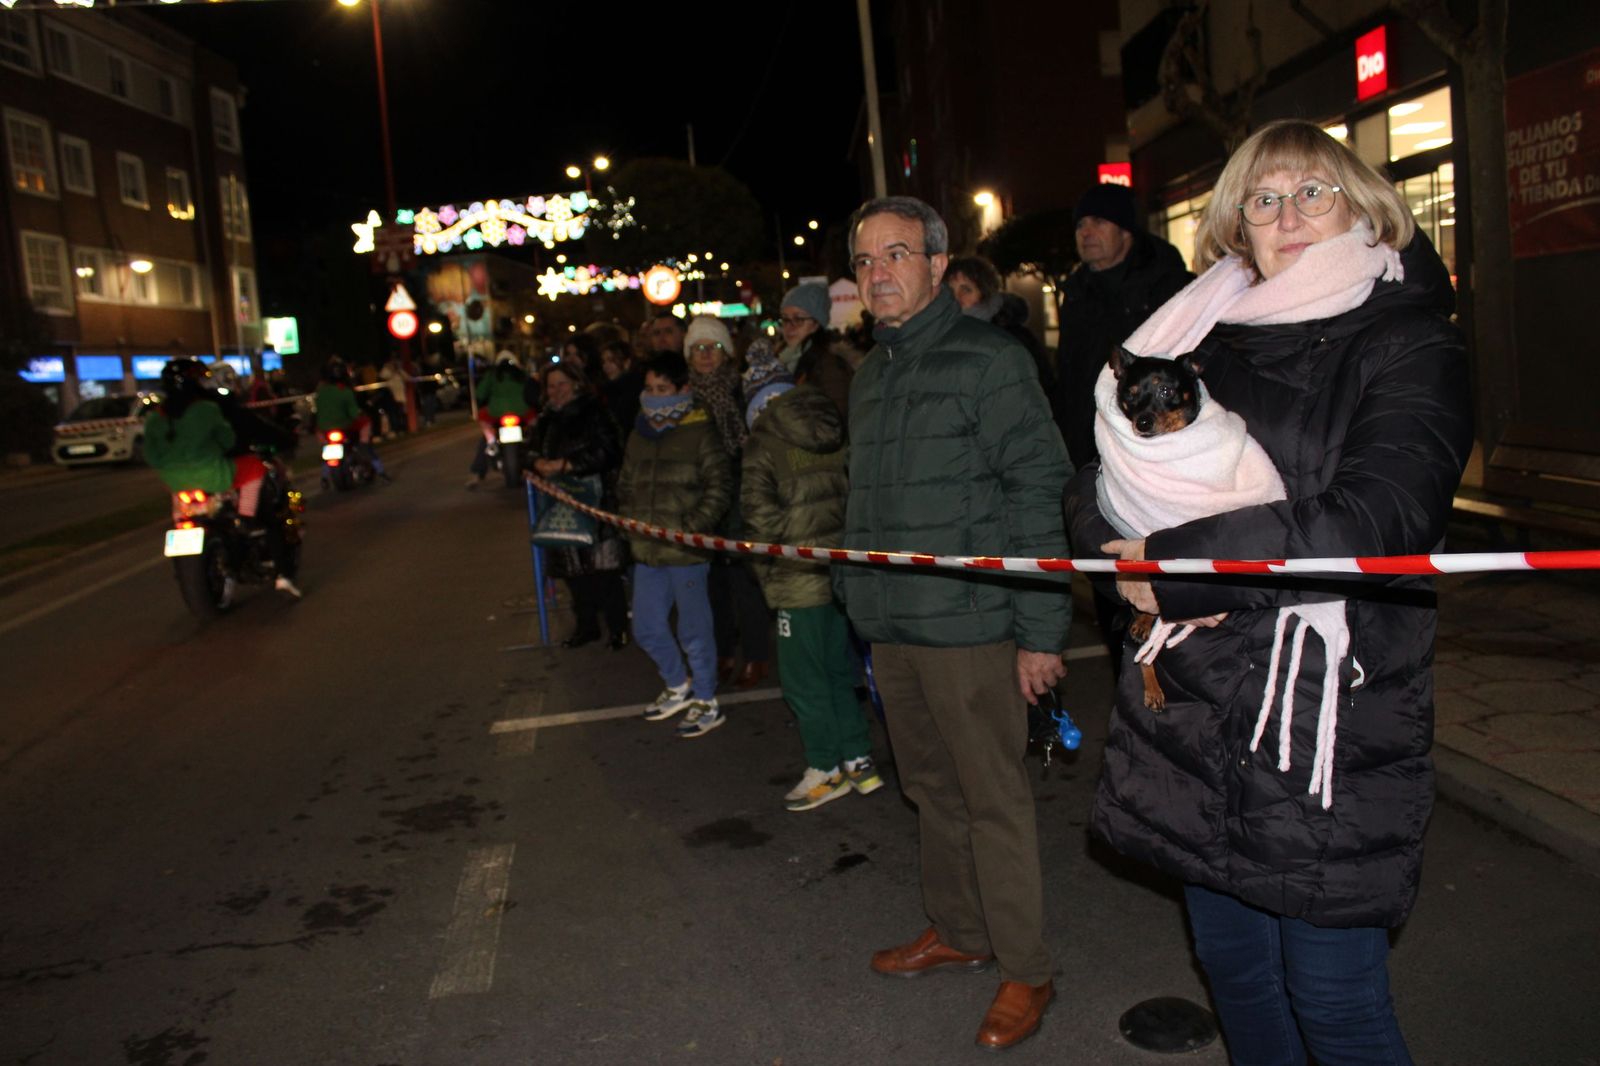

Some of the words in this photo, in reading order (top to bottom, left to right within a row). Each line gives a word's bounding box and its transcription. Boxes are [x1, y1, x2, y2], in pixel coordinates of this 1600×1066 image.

[1506, 112, 1583, 144] PLIAMOS
[1507, 135, 1577, 167] SURTIDO
[1520, 165, 1541, 184] DE
[1545, 160, 1567, 178] TU
[1519, 176, 1582, 204] TIENDA
